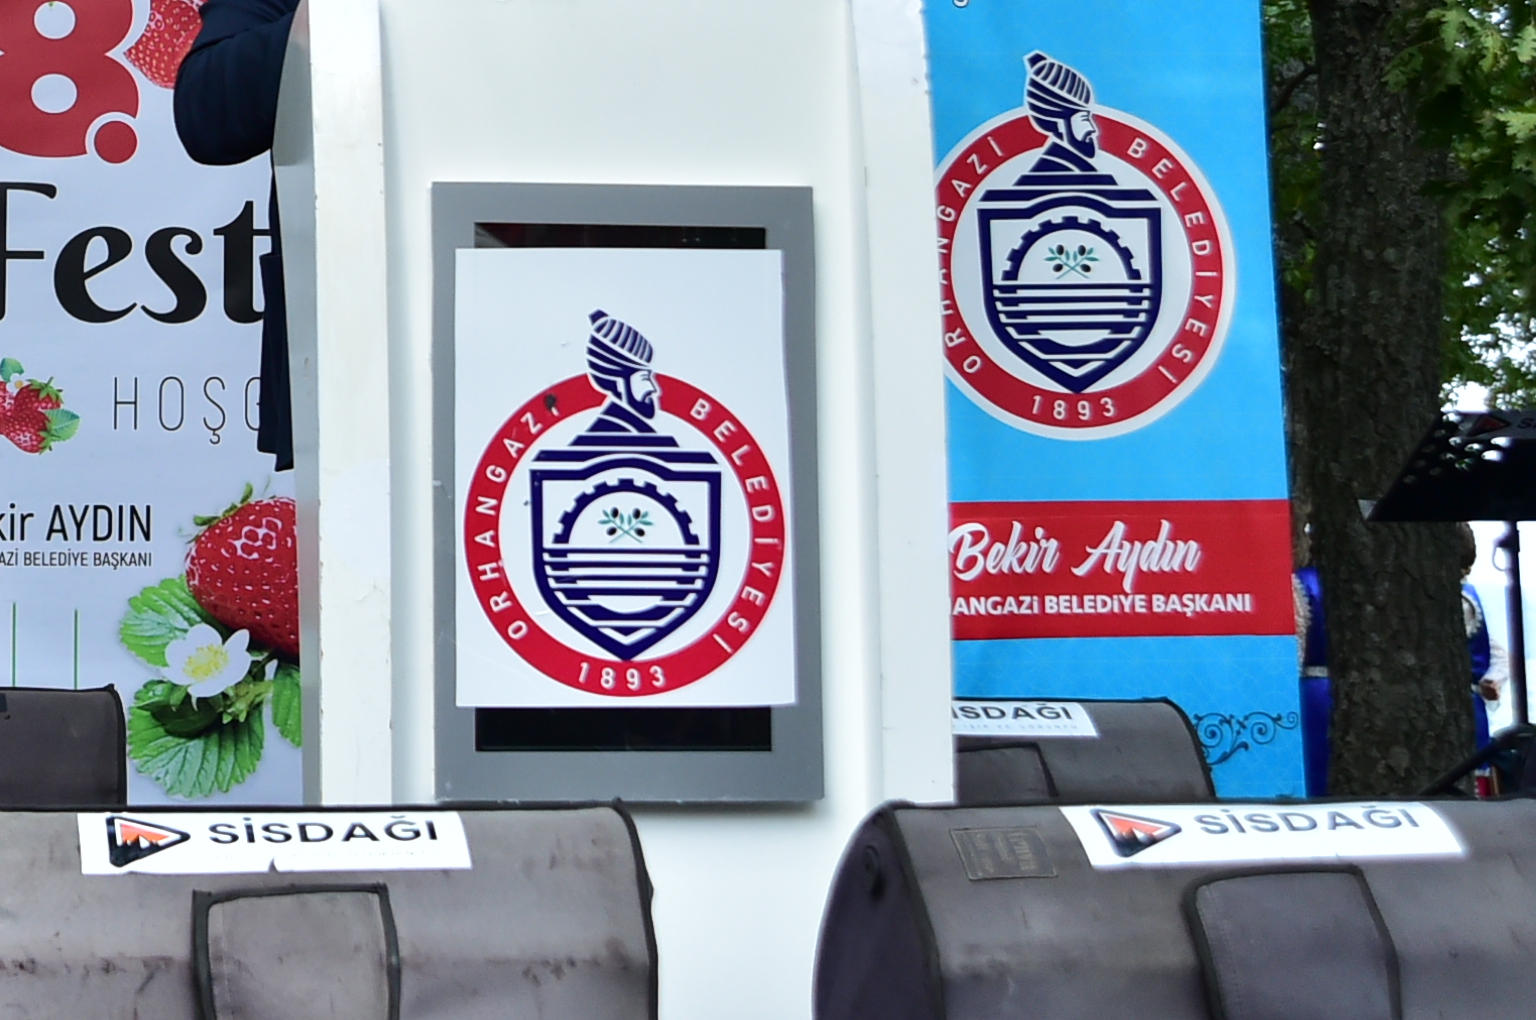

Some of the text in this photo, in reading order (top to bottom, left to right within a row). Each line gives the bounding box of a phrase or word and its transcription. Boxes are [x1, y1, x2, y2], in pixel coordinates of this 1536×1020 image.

[113, 375, 262, 445] HOŞG
[1031, 394, 1117, 420] 1893
[45, 504, 152, 543] AYDIN
[23, 548, 89, 567] BELEDİYE
[93, 551, 153, 571] BAŞKANI
[948, 519, 1203, 593] Bekir Aydın
[1152, 592, 1252, 618] BAŞKANI
[578, 661, 666, 691] 1893
[208, 815, 438, 845] SİSDAĞI
[1193, 804, 1420, 835] SİSDAĞI
